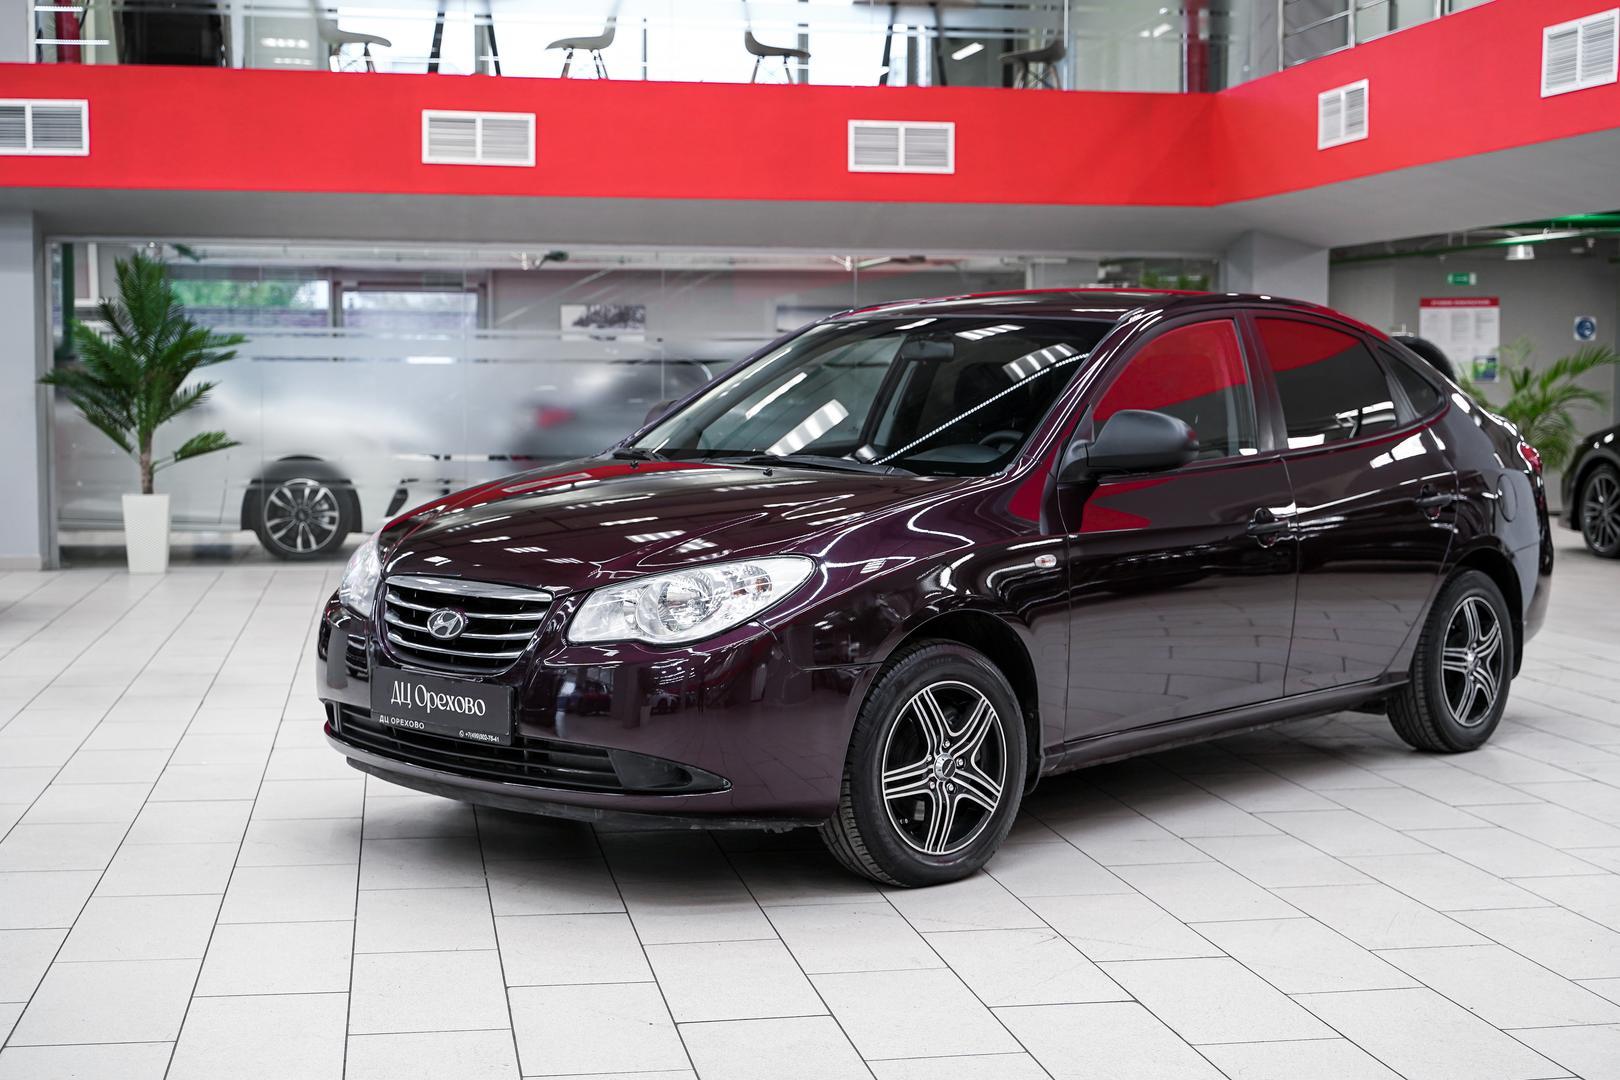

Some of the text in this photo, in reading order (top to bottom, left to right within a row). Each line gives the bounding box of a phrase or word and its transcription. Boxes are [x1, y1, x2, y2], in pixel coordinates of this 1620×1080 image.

[391, 680, 486, 716] ДЦ Орехово
[379, 714, 425, 730] ДЦ ОРЕХОВО
